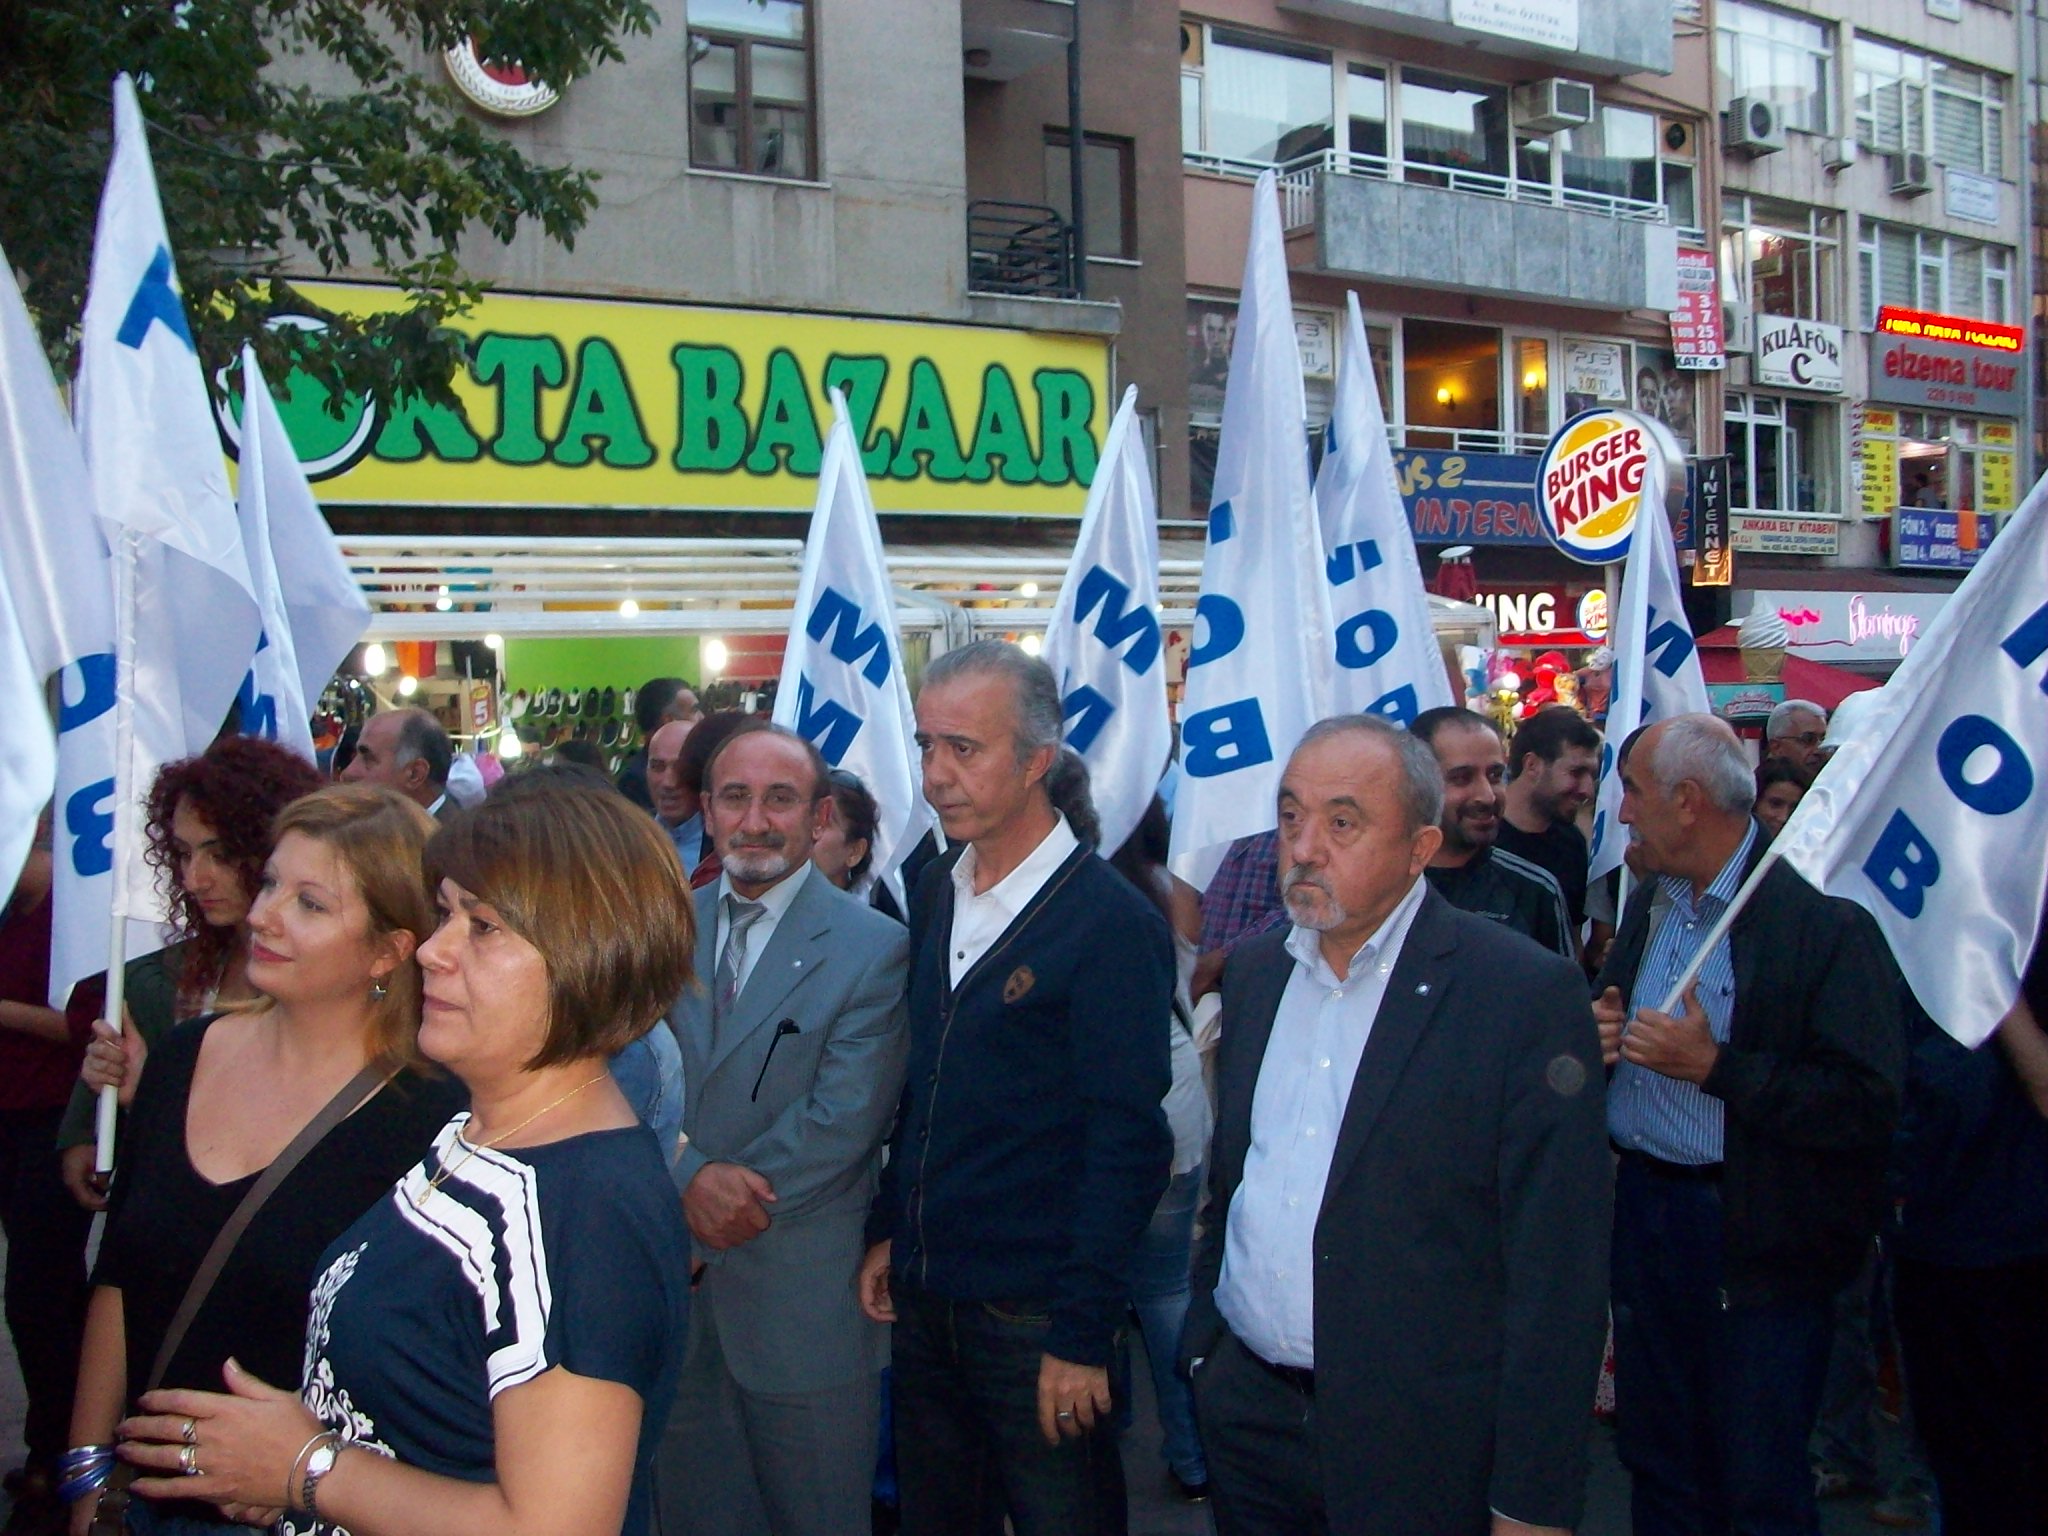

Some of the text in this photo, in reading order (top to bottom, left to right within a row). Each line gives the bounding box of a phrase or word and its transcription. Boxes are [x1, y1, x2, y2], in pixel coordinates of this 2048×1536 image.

[1697, 325, 1714, 338] 25
[1698, 340, 1716, 353] 30
[1761, 322, 1838, 367] KUAFÖR
[1575, 350, 1612, 366] PS3
[1790, 352, 1812, 385] C
[1884, 343, 2017, 392] elzema tour
[672, 343, 1098, 488] BAZAAR
[1437, 456, 1467, 489] 2
[1547, 428, 1643, 498] BURGER
[1552, 454, 1647, 539] KING
[1415, 496, 1547, 538] INTERN
[1703, 465, 1721, 577] INTERNET
[1742, 519, 1777, 532] ANKARA
[1779, 521, 1795, 533] ELT
[1475, 592, 1556, 632] ING
[474, 700, 488, 726] 5
